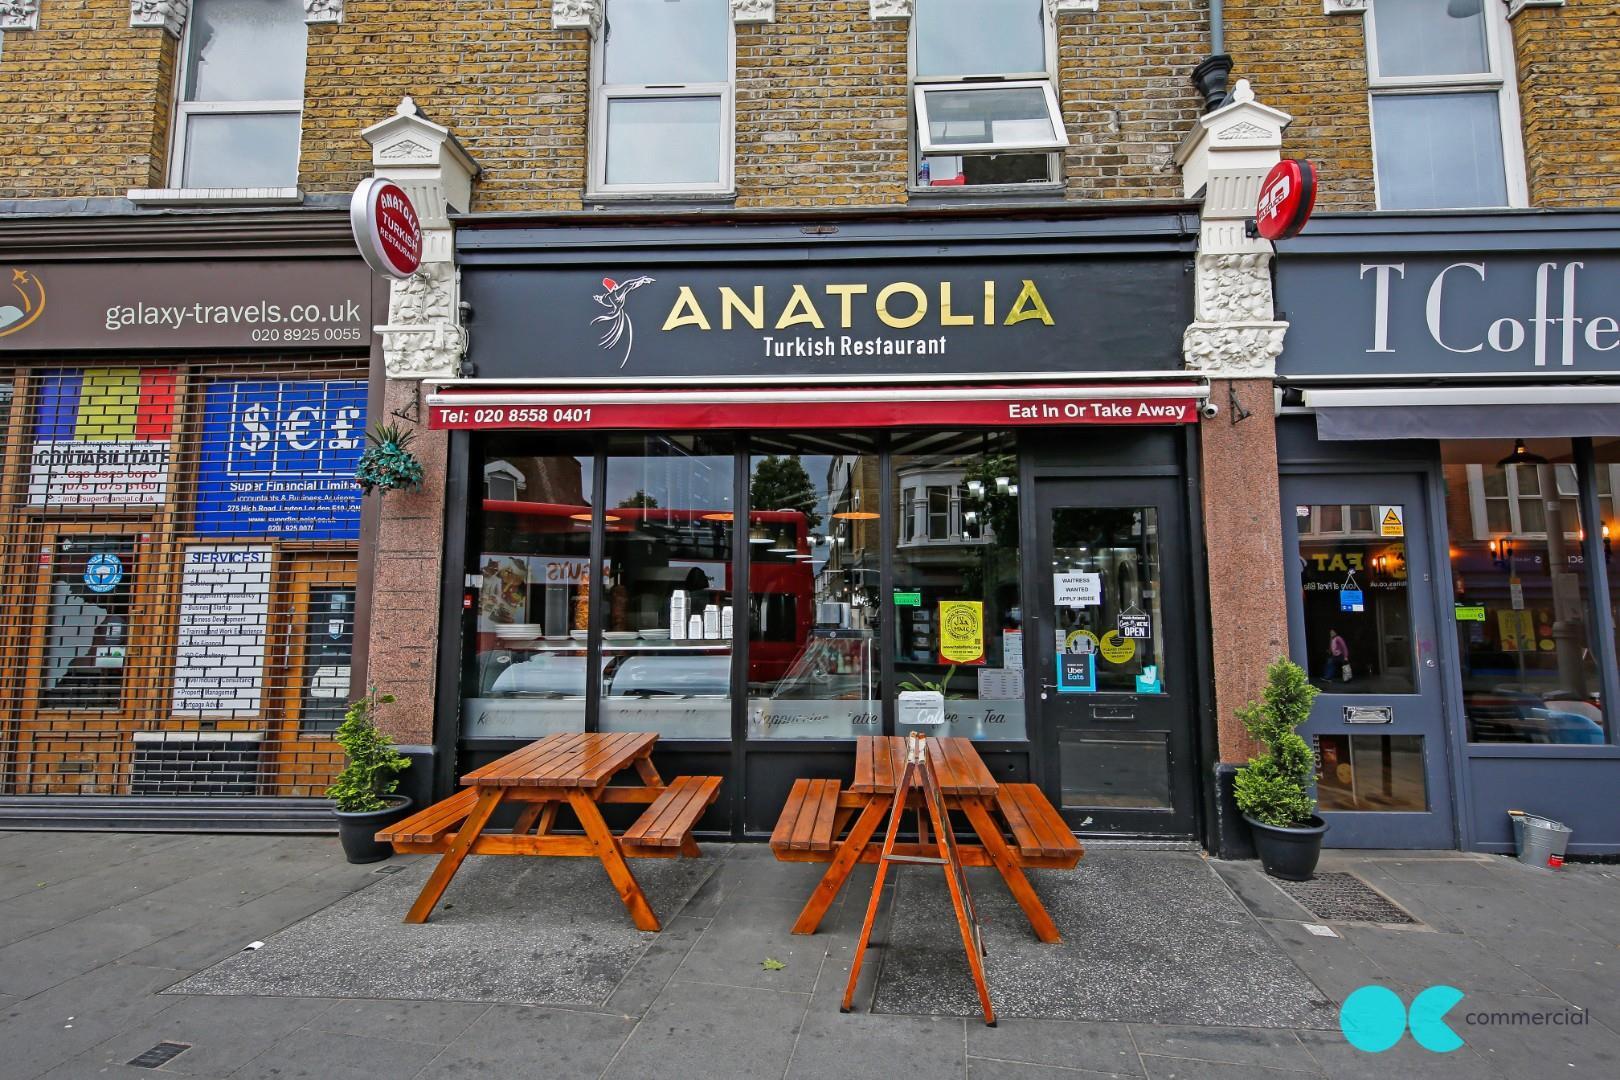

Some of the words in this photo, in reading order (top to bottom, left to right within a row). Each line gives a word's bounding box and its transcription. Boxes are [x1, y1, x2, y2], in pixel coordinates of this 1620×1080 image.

[381, 193, 420, 242] ANATOLIA
[383, 211, 418, 252] TURKISH
[380, 227, 417, 264] RESTAURANT
[661, 279, 1055, 330] ANATOLIA
[1360, 261, 1404, 353] T
[105, 299, 361, 330] galaxy-travels.co.uk
[251, 328, 279, 341] 020
[282, 328, 319, 341] 8925
[324, 327, 361, 340] 0055
[763, 336, 835, 358] Turkish
[839, 334, 947, 357] Restaurant
[440, 409, 470, 423] Tel:
[474, 409, 504, 423] 020
[508, 408, 548, 422] 8558
[553, 408, 592, 422] 0401
[1009, 404, 1038, 418] Eat
[1043, 404, 1059, 418] In
[1064, 403, 1086, 417] Or
[1091, 403, 1133, 417] Take
[1137, 402, 1186, 420] Away
[39, 450, 170, 466] CONTABILITATE
[230, 481, 264, 492] Super
[267, 480, 317, 492] Financial
[280, 494, 288, 502] &
[193, 552, 260, 563] SERVICES
[212, 616, 246, 624] Deveopment
[1124, 626, 1145, 637] OPEN
[848, 710, 879, 725] atte
[984, 708, 1005, 724] Tea
